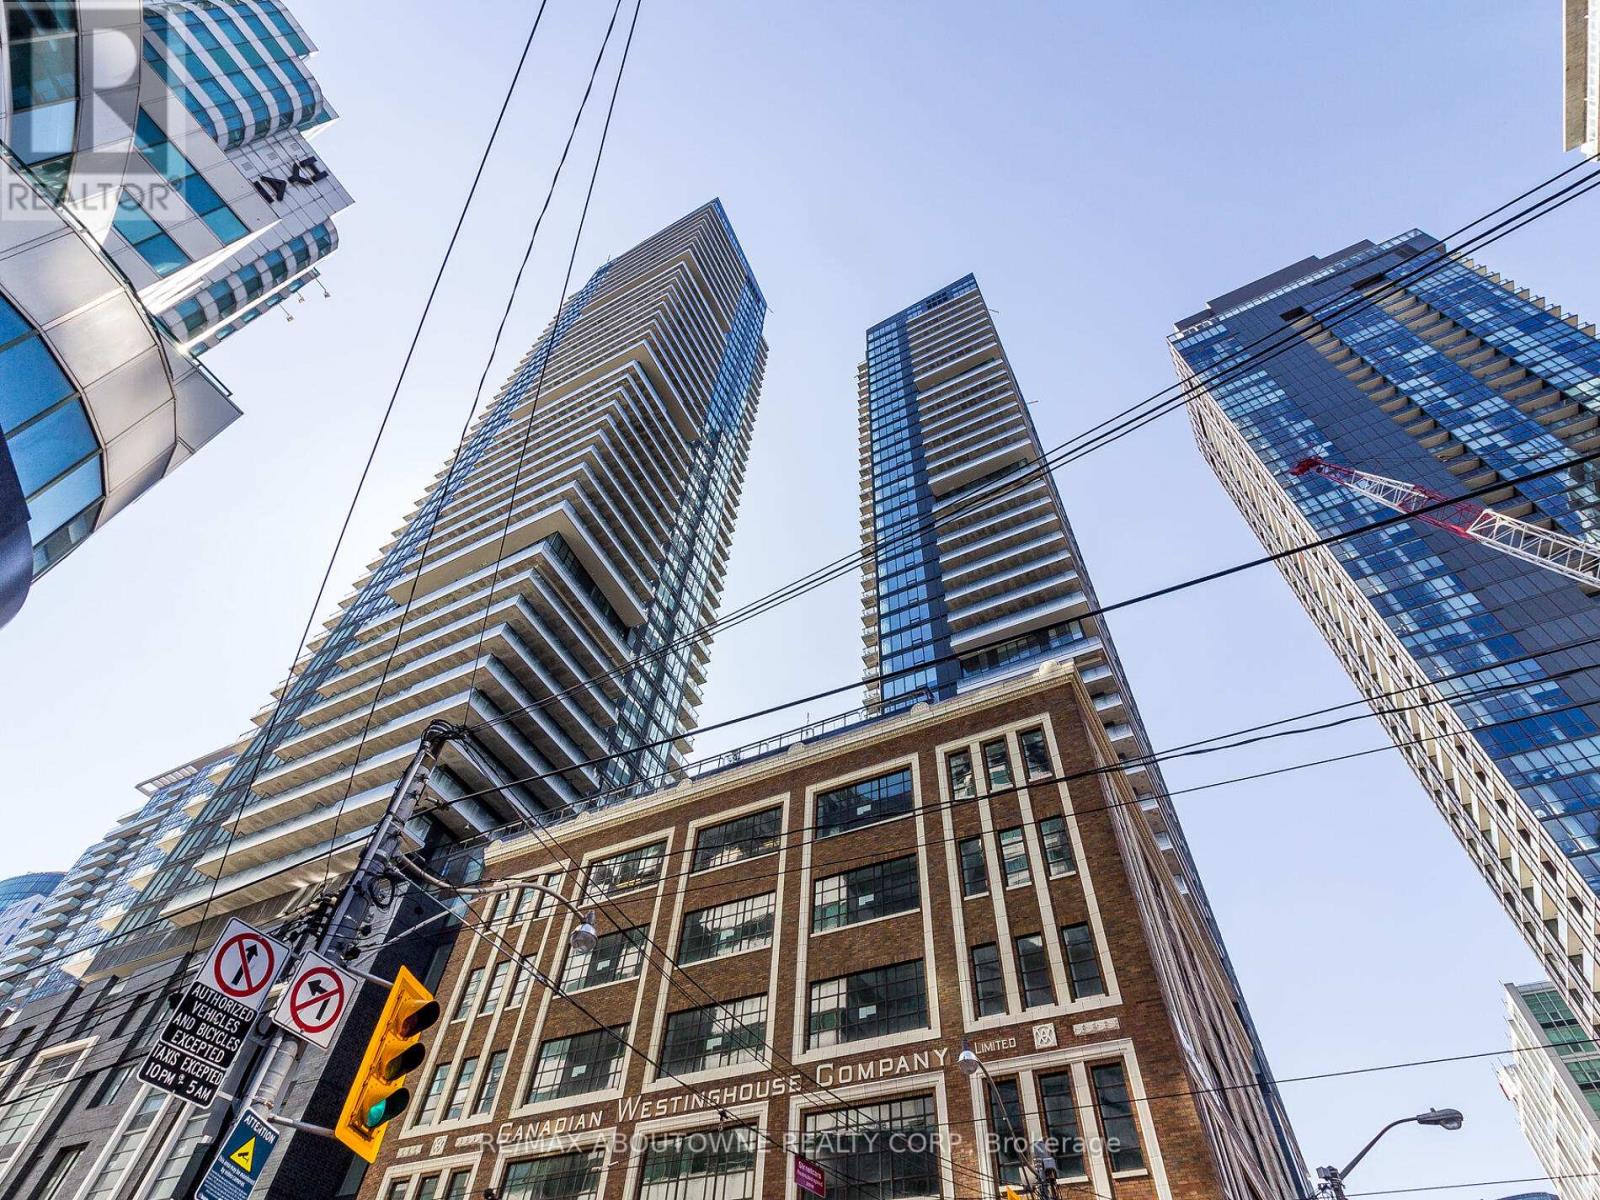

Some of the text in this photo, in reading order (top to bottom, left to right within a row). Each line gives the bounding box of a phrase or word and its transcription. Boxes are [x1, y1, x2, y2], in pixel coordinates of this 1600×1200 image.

[192, 985, 255, 1022] AUTHORIZED
[192, 1001, 241, 1034] VEHICLES
[171, 1030, 225, 1063] EXCEPTED
[173, 1012, 241, 1052] AND BICYCLES
[153, 1043, 224, 1085] TAXIS EXCEPTED
[497, 1038, 1016, 1144] CANADIAN WESTINGHOUSE COMPANY LIMITED
